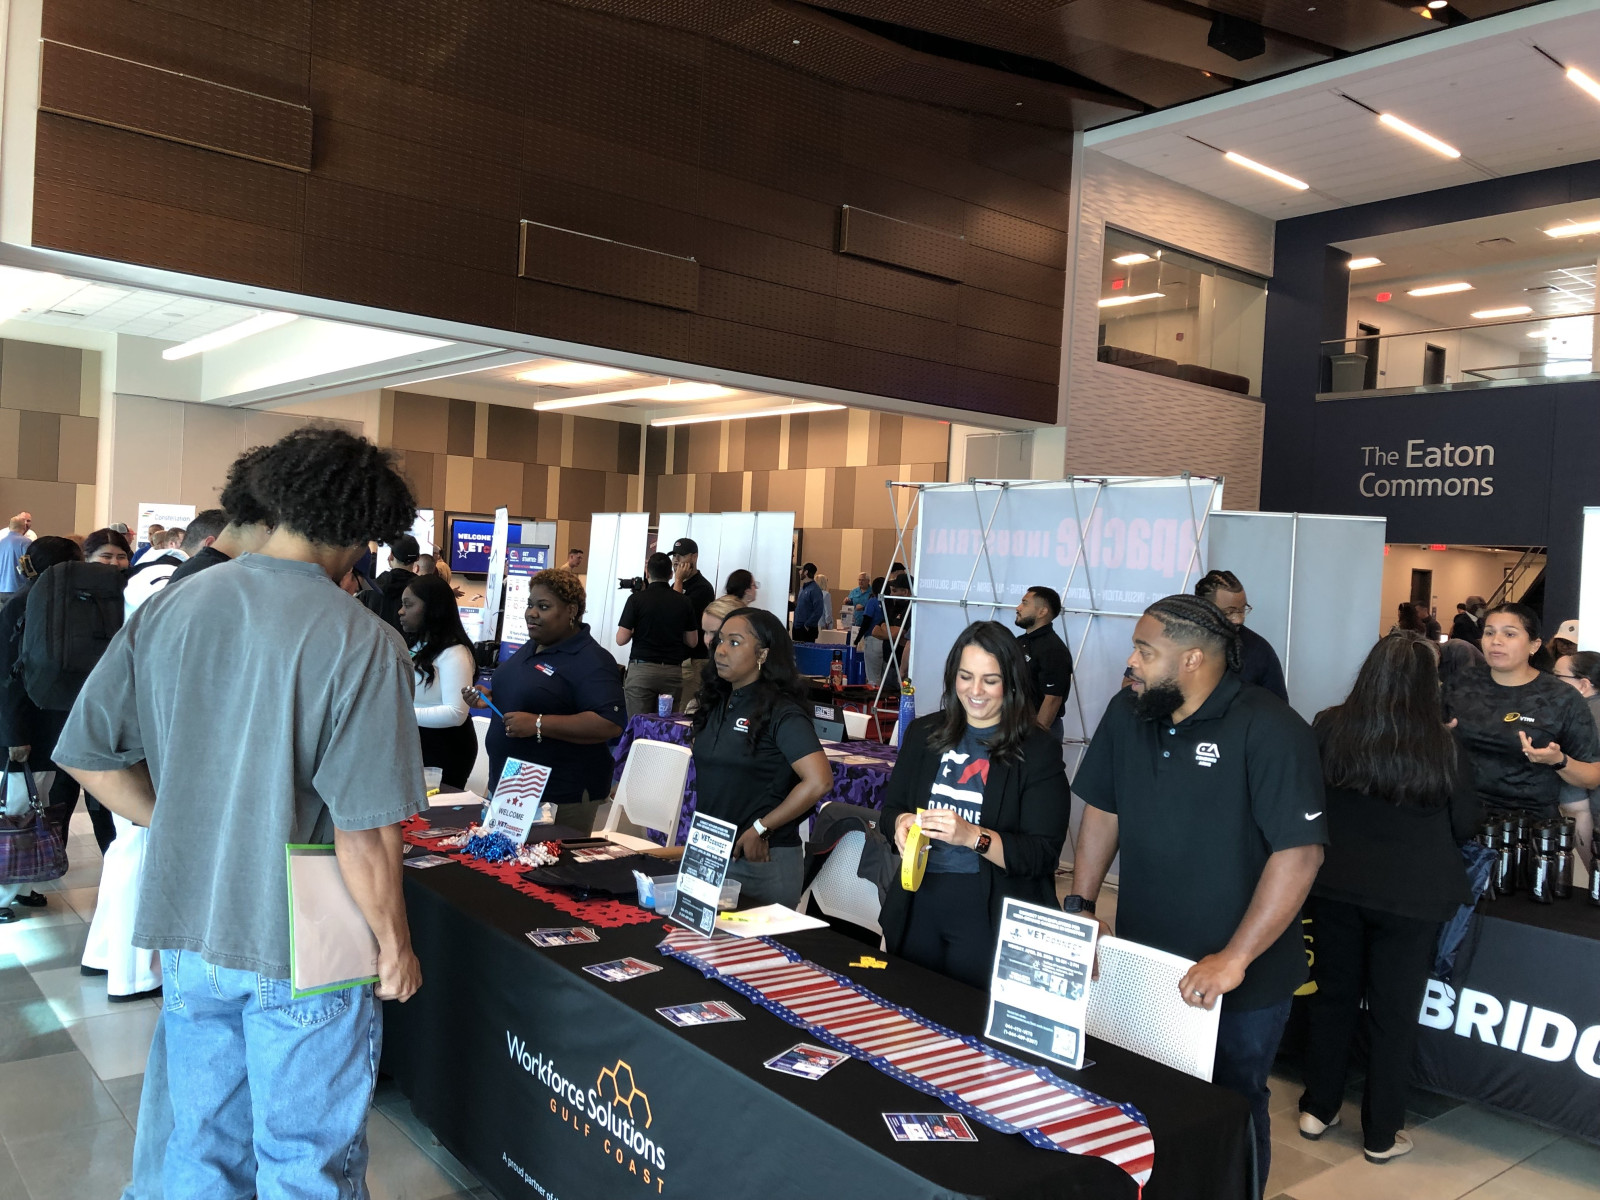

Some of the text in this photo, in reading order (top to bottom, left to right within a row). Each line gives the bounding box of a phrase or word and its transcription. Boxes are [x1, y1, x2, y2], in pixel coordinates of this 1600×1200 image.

[1360, 439, 1495, 468] The Eaton
[1359, 472, 1494, 498] Commons
[457, 533, 491, 541] WELCOME
[499, 808, 524, 820] WELCOME
[506, 1030, 666, 1170] Workforce Solutions
[550, 1098, 664, 1194] GULF COAST
[502, 1151, 507, 1163] A
[507, 1157, 524, 1178] proud
[524, 1172, 546, 1197] partner
